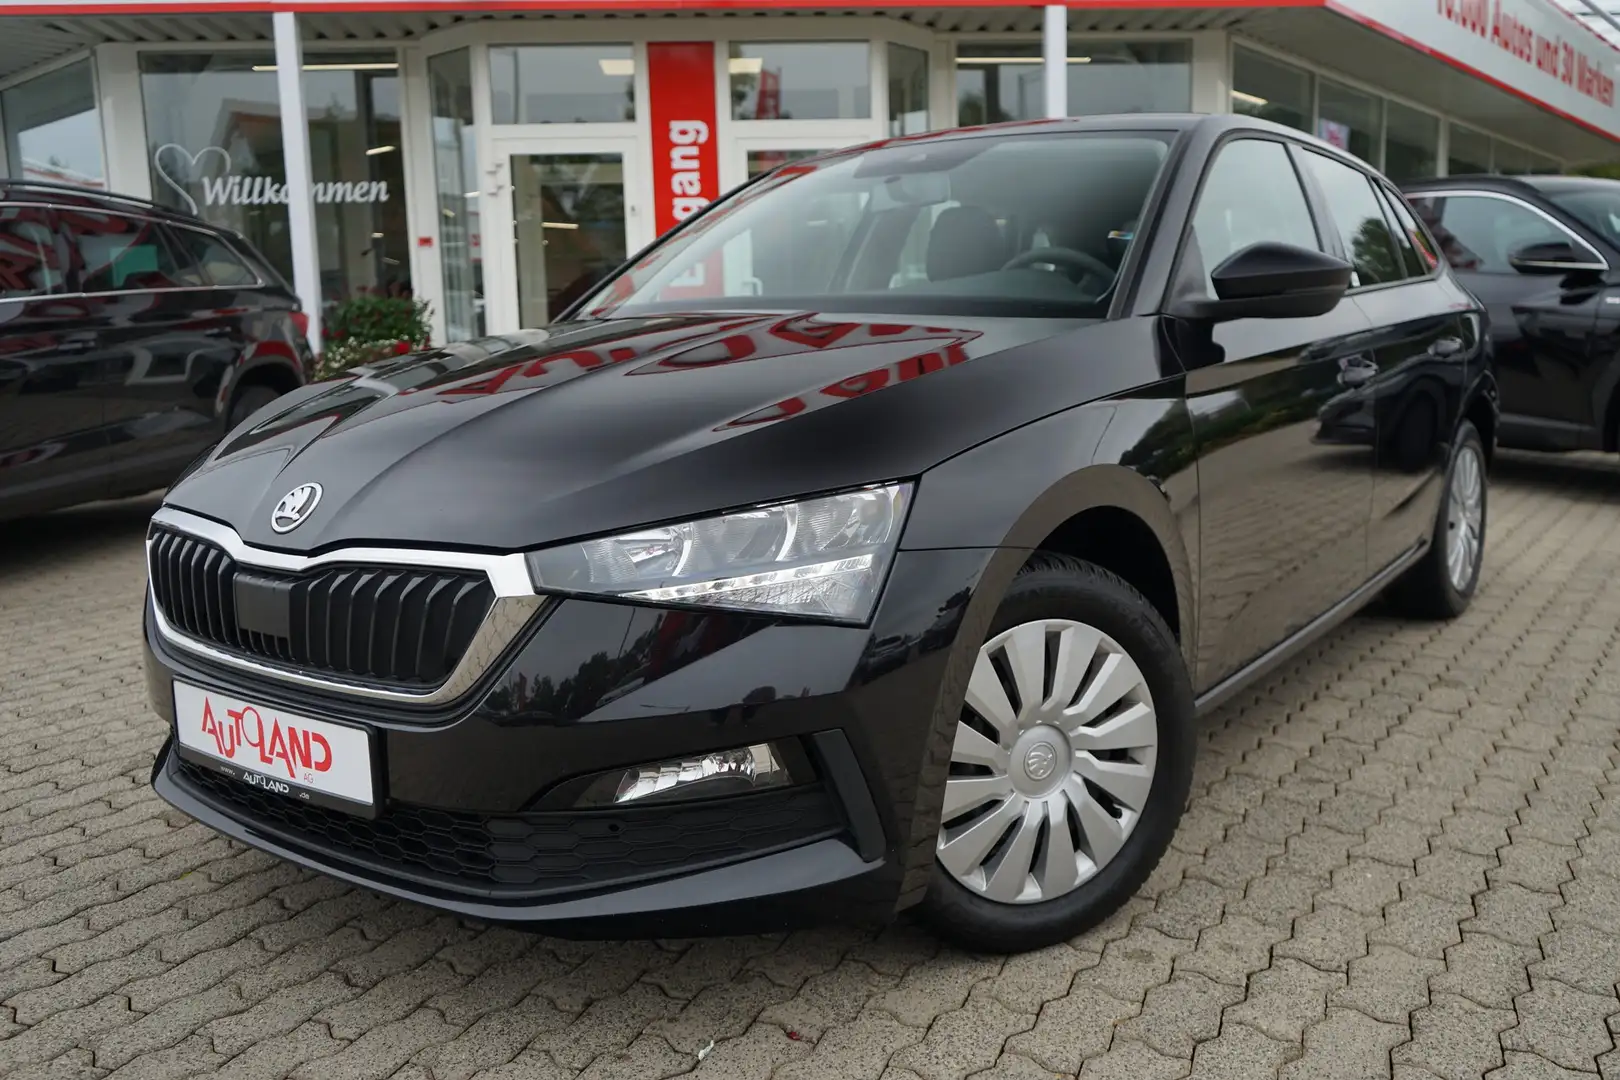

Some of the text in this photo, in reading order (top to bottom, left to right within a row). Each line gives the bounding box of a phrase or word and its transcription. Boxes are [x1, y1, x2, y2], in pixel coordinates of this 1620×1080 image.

[1491, 0, 1532, 64] Autos
[1537, 33, 1559, 78] und
[1561, 40, 1574, 87] 30
[1577, 51, 1613, 108] Marken
[667, 119, 709, 287] Egang
[303, 772, 313, 784] AG
